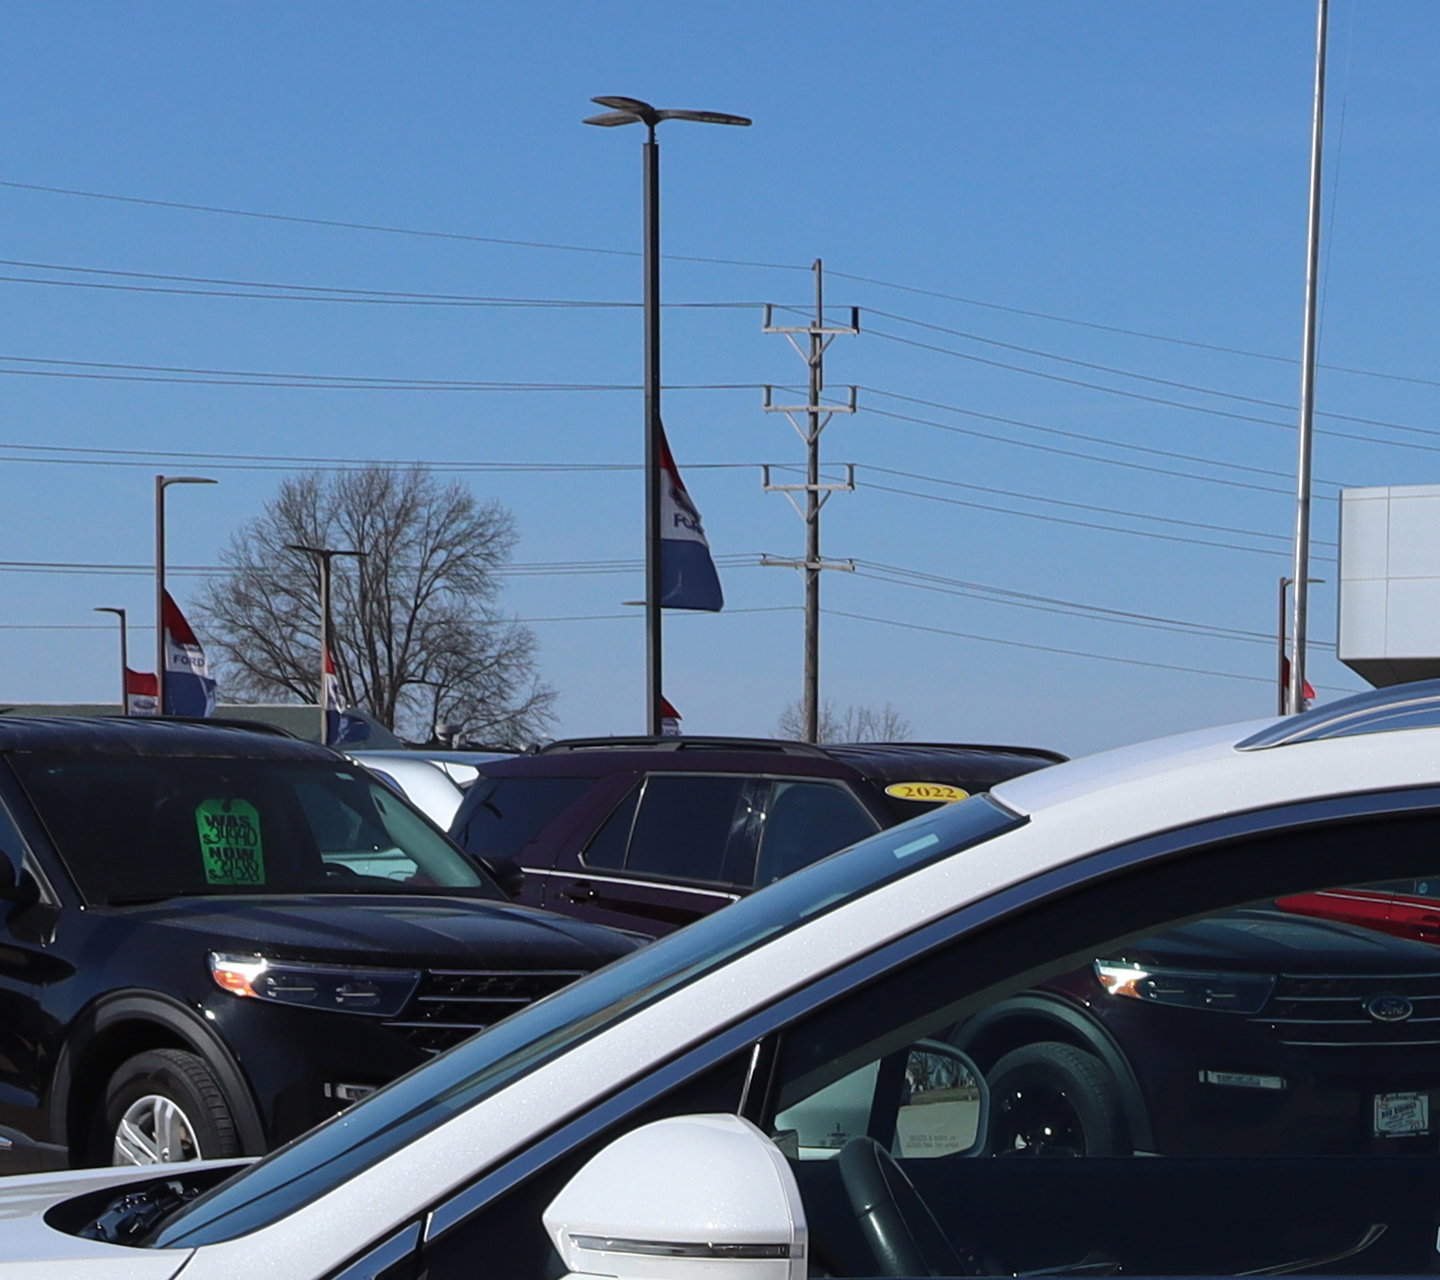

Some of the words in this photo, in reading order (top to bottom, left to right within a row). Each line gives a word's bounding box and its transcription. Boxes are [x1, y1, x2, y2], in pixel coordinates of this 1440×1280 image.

[173, 655, 205, 667] FORD
[901, 786, 957, 799] 2022
[203, 814, 251, 827] WAS
[209, 846, 256, 860] NOW
